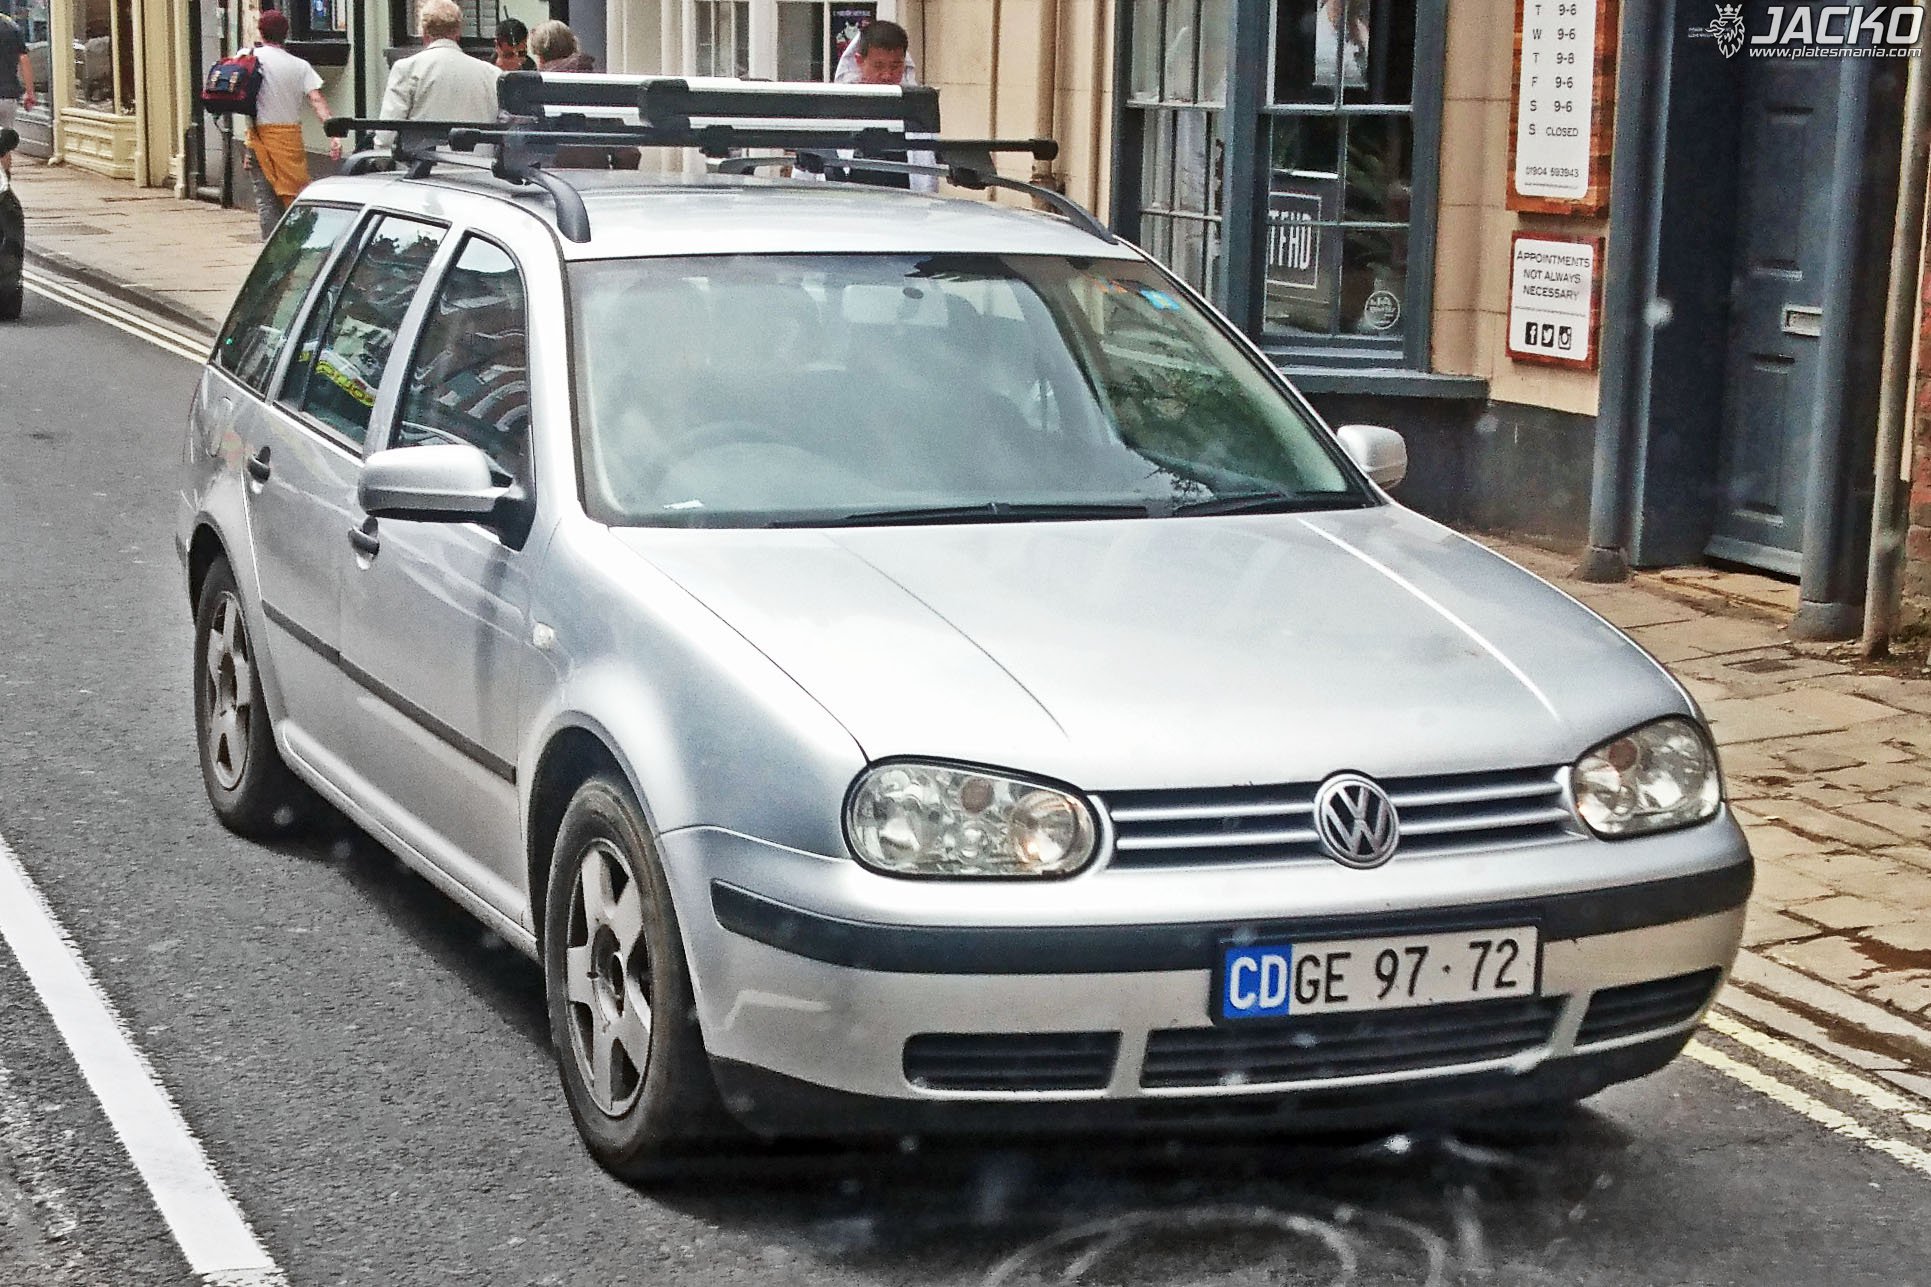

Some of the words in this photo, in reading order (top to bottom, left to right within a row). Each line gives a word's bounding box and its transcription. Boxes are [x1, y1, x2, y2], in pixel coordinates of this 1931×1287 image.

[1535, 5, 1542, 16] T
[1532, 28, 1542, 40] W
[1557, 28, 1576, 40] 9-6
[1532, 52, 1540, 64] T
[1531, 76, 1538, 87] F
[1555, 76, 1573, 88] 9-6
[1529, 100, 1537, 112] S
[1554, 100, 1573, 112] 9-6
[1528, 123, 1536, 135] S
[1545, 126, 1579, 137] CLOSED
[1516, 250, 1591, 268] APPOINTMENTS
[1523, 269, 1543, 280] NOT
[1544, 271, 1581, 284] ALWAYS
[1522, 284, 1580, 301] NECESSARY
[1229, 954, 1287, 1010] CD
[1294, 951, 1352, 1005] GE
[1374, 945, 1429, 1000] 97
[1468, 938, 1520, 992] 72
